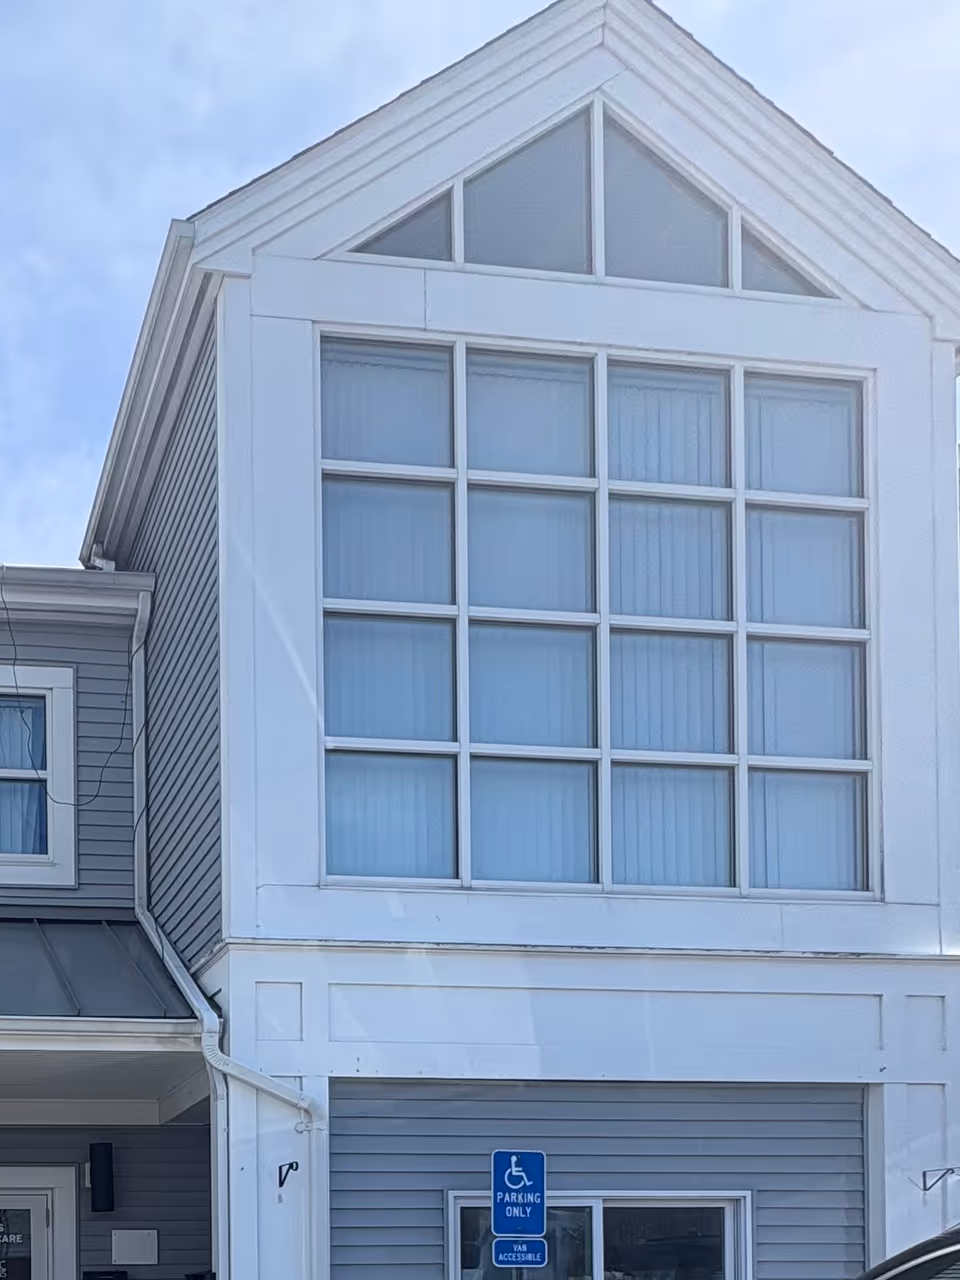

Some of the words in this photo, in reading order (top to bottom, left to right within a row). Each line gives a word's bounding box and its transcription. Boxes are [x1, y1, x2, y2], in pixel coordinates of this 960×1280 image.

[497, 1193, 541, 1203] PARKING
[505, 1206, 532, 1217] ONLY
[498, 1253, 541, 1261] ACCESSIBLE
